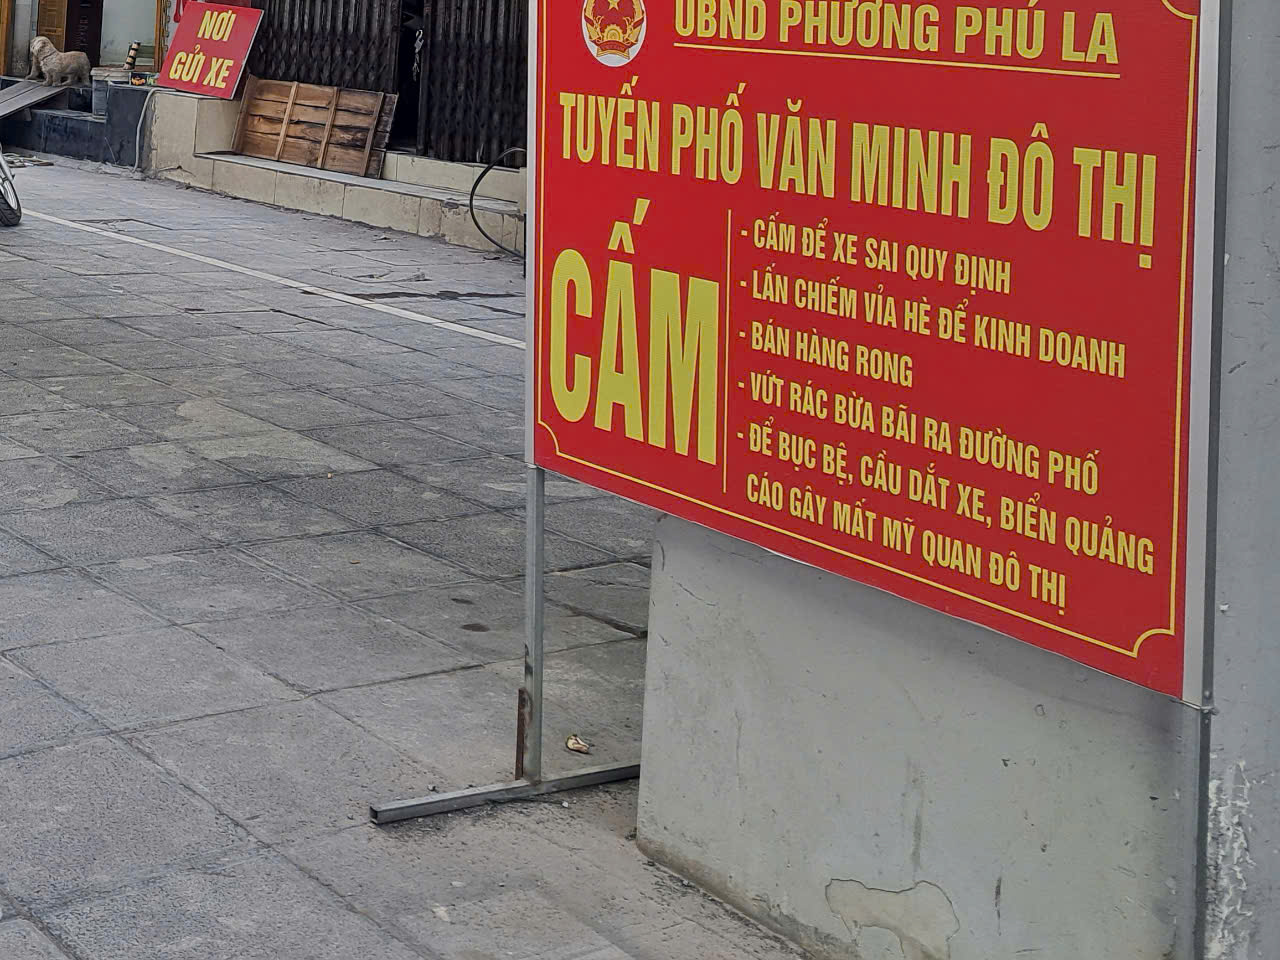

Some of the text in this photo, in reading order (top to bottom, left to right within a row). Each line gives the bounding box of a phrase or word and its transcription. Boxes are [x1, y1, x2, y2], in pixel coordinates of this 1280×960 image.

[169, 43, 234, 89] GỬI XE
[197, 9, 237, 42] NƠI
[1061, 11, 1119, 65] LA
[559, 75, 1157, 269] TUYẾN PHỐ VĂN MINH ĐÔ THỊ
[753, 211, 796, 254] CẤM
[801, 217, 828, 260] ĐỂ
[832, 231, 857, 265] XE
[864, 237, 899, 273] SAI
[905, 244, 948, 281] QUY
[954, 252, 1011, 296] ĐỊNH
[549, 197, 720, 465] CẤM
[751, 318, 790, 357] BÁN
[795, 327, 849, 372] HÀNG
[855, 344, 913, 388] RONG
[752, 266, 789, 305] LẤN
[794, 276, 857, 320] CHIẾM
[863, 283, 897, 328] VỈA
[904, 296, 931, 336] HÈ
[937, 298, 969, 343] ĐỂ
[974, 314, 1031, 358] KINH
[1038, 327, 1126, 379] DOANH
[750, 369, 785, 407] VỨT
[789, 379, 828, 420] RÁC
[834, 391, 875, 433] BỪA
[881, 403, 917, 444] BÃI
[923, 416, 952, 455] RA
[958, 426, 1040, 480] ĐƯỜNG
[1048, 449, 1100, 495] PHỐ
[746, 471, 1066, 616] CÁO GÂY MẤT MỸ QUAN ĐÔ THỊ
[749, 415, 774, 456] ĐỂ
[778, 430, 817, 472] BỤC
[822, 441, 853, 486] BỆ,
[860, 449, 902, 495] CẦU
[908, 462, 950, 510] DẮT
[956, 483, 992, 529] XE,
[999, 492, 1057, 545] BIỂN
[1064, 515, 1154, 575] QUẢNG
